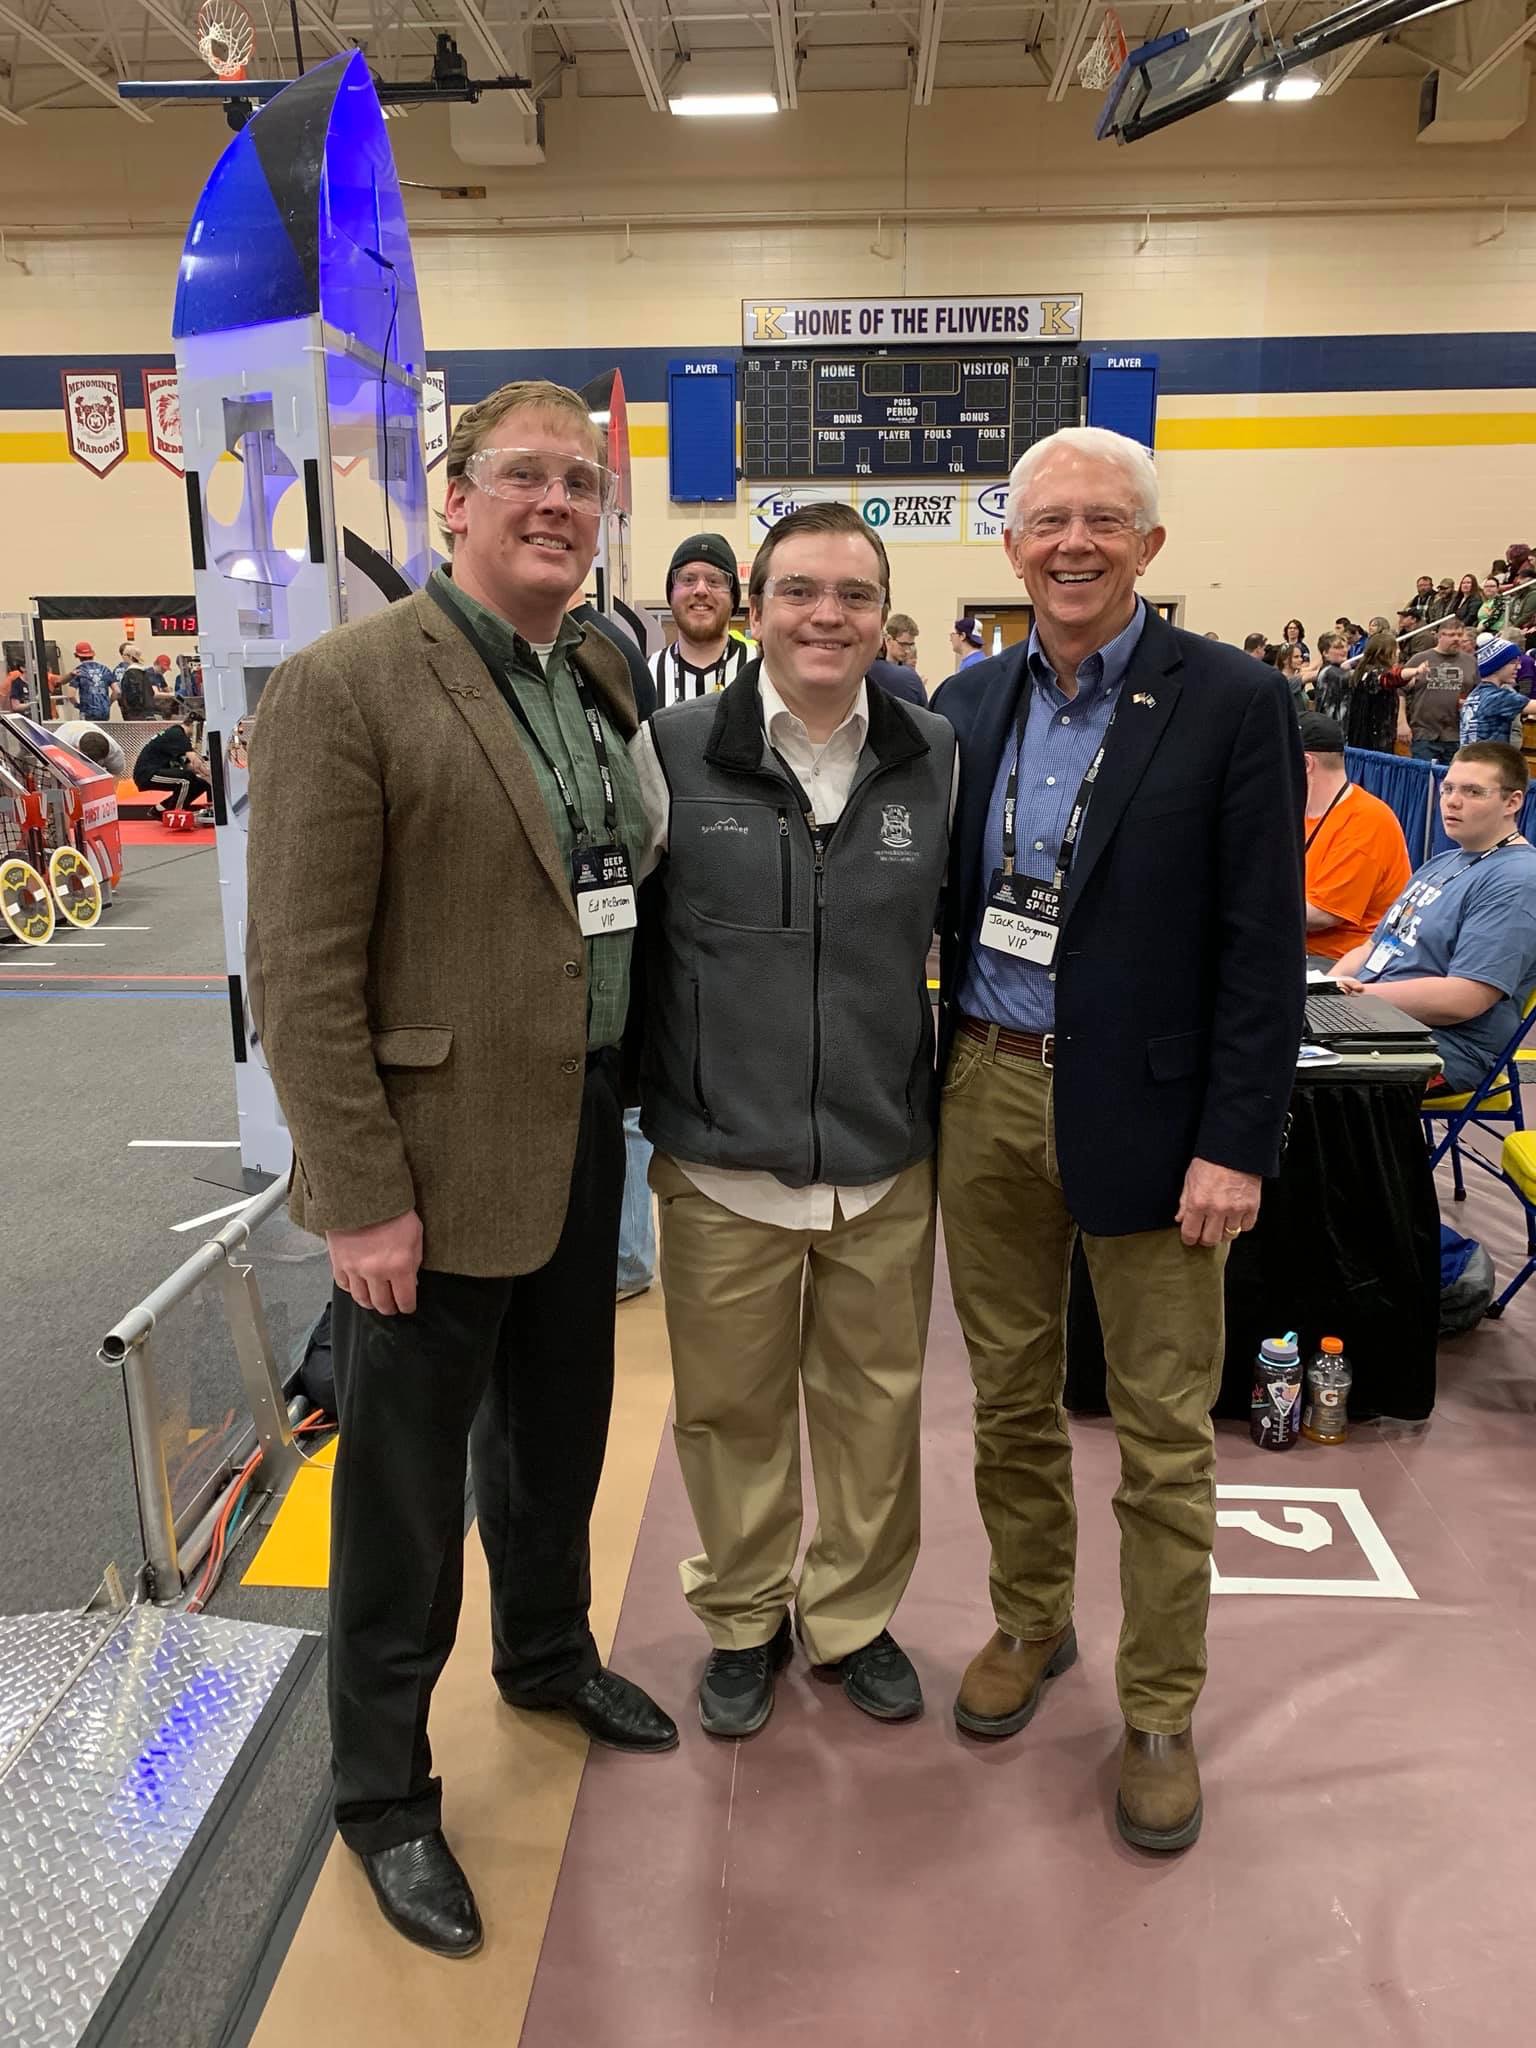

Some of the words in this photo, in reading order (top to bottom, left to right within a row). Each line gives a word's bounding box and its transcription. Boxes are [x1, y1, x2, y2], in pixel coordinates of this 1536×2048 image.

[753, 306, 787, 339] K
[795, 309, 851, 335] HOME
[859, 308, 884, 334] OF
[891, 307, 928, 334] THE
[935, 305, 1029, 333] FLIVVERS
[1040, 302, 1075, 334] K
[748, 361, 760, 371] NO
[774, 361, 781, 370] F
[791, 360, 808, 369] PTS
[1017, 357, 1030, 366] NO
[1044, 357, 1050, 366] F
[1061, 356, 1078, 365] PTS
[1107, 358, 1141, 368] PLAYER
[685, 364, 718, 374] PLAYER
[821, 365, 855, 377] HOME
[962, 362, 1009, 375] VISITOR
[68, 380, 117, 396] MENOMINEE
[886, 407, 918, 417] PERIOD
[960, 412, 989, 421] BONUS
[833, 414, 862, 424] BONUS
[819, 431, 845, 440] FOULS
[878, 430, 910, 439] PLAYER
[924, 429, 951, 438] FOULS
[978, 429, 1005, 438] FOULS
[77, 437, 120, 453] MAROONS
[856, 464, 872, 473] TOL
[948, 463, 965, 472] TOL
[892, 496, 956, 510] FIRST
[892, 511, 952, 525] BANK
[975, 521, 996, 535] The
[603, 856, 623, 867] DEEP
[602, 866, 628, 880] SPACE
[1031, 889, 1059, 904] DEEP
[588, 899, 599, 912] Ed
[1025, 898, 1060, 917] SPACE
[601, 914, 615, 928] VIP
[990, 913, 1014, 929] Jack
[1017, 921, 1053, 940] Bergman
[1008, 934, 1027, 949] VIP
[1320, 1390, 1338, 1407] G
